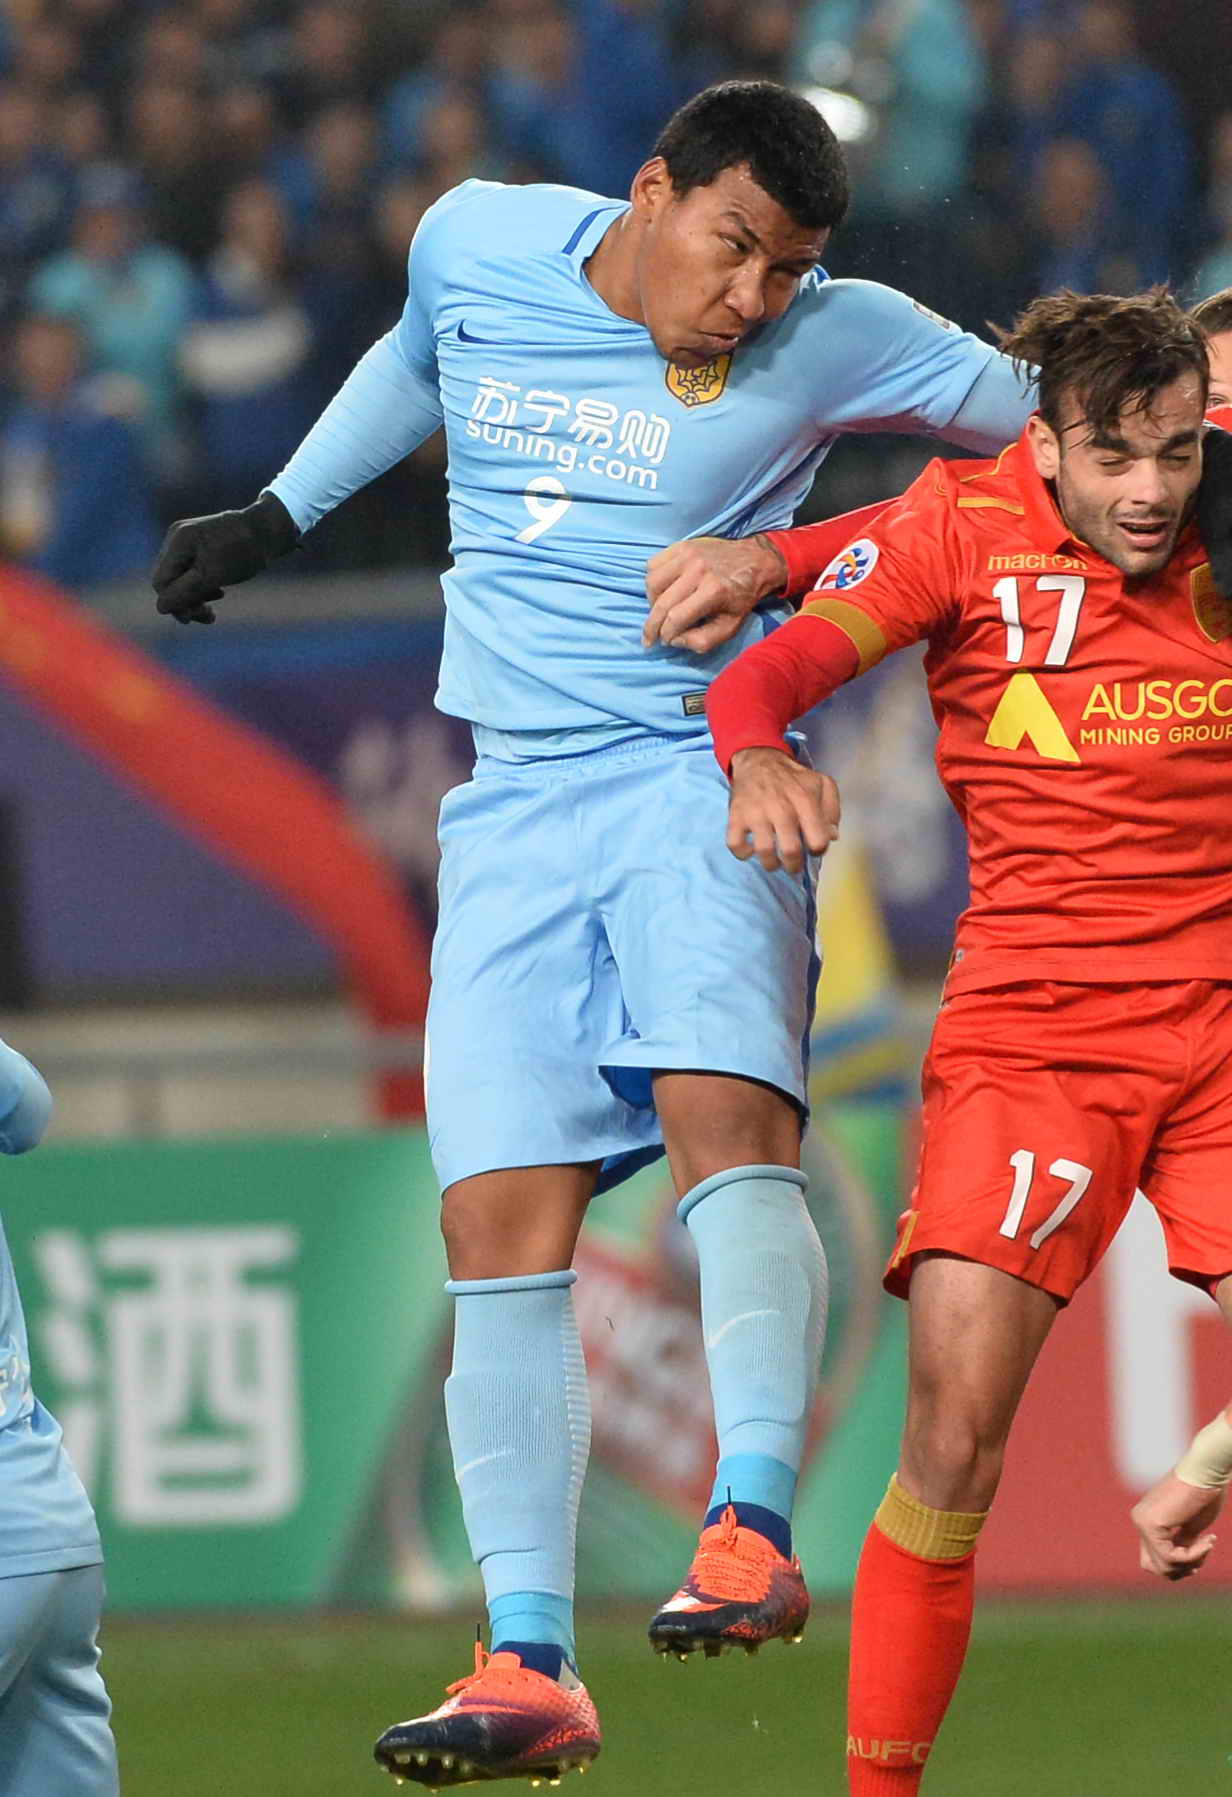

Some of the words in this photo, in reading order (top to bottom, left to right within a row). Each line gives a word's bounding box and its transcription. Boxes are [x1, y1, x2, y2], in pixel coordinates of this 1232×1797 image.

[465, 419, 659, 490] suning.com
[471, 376, 672, 465] 苏宁易购
[513, 476, 573, 545] 9
[986, 553, 1089, 571] macron
[991, 574, 1087, 667] 17
[1080, 727, 1161, 746] MINING
[999, 1148, 1094, 1251] 17
[35, 1223, 300, 1528] 酒
